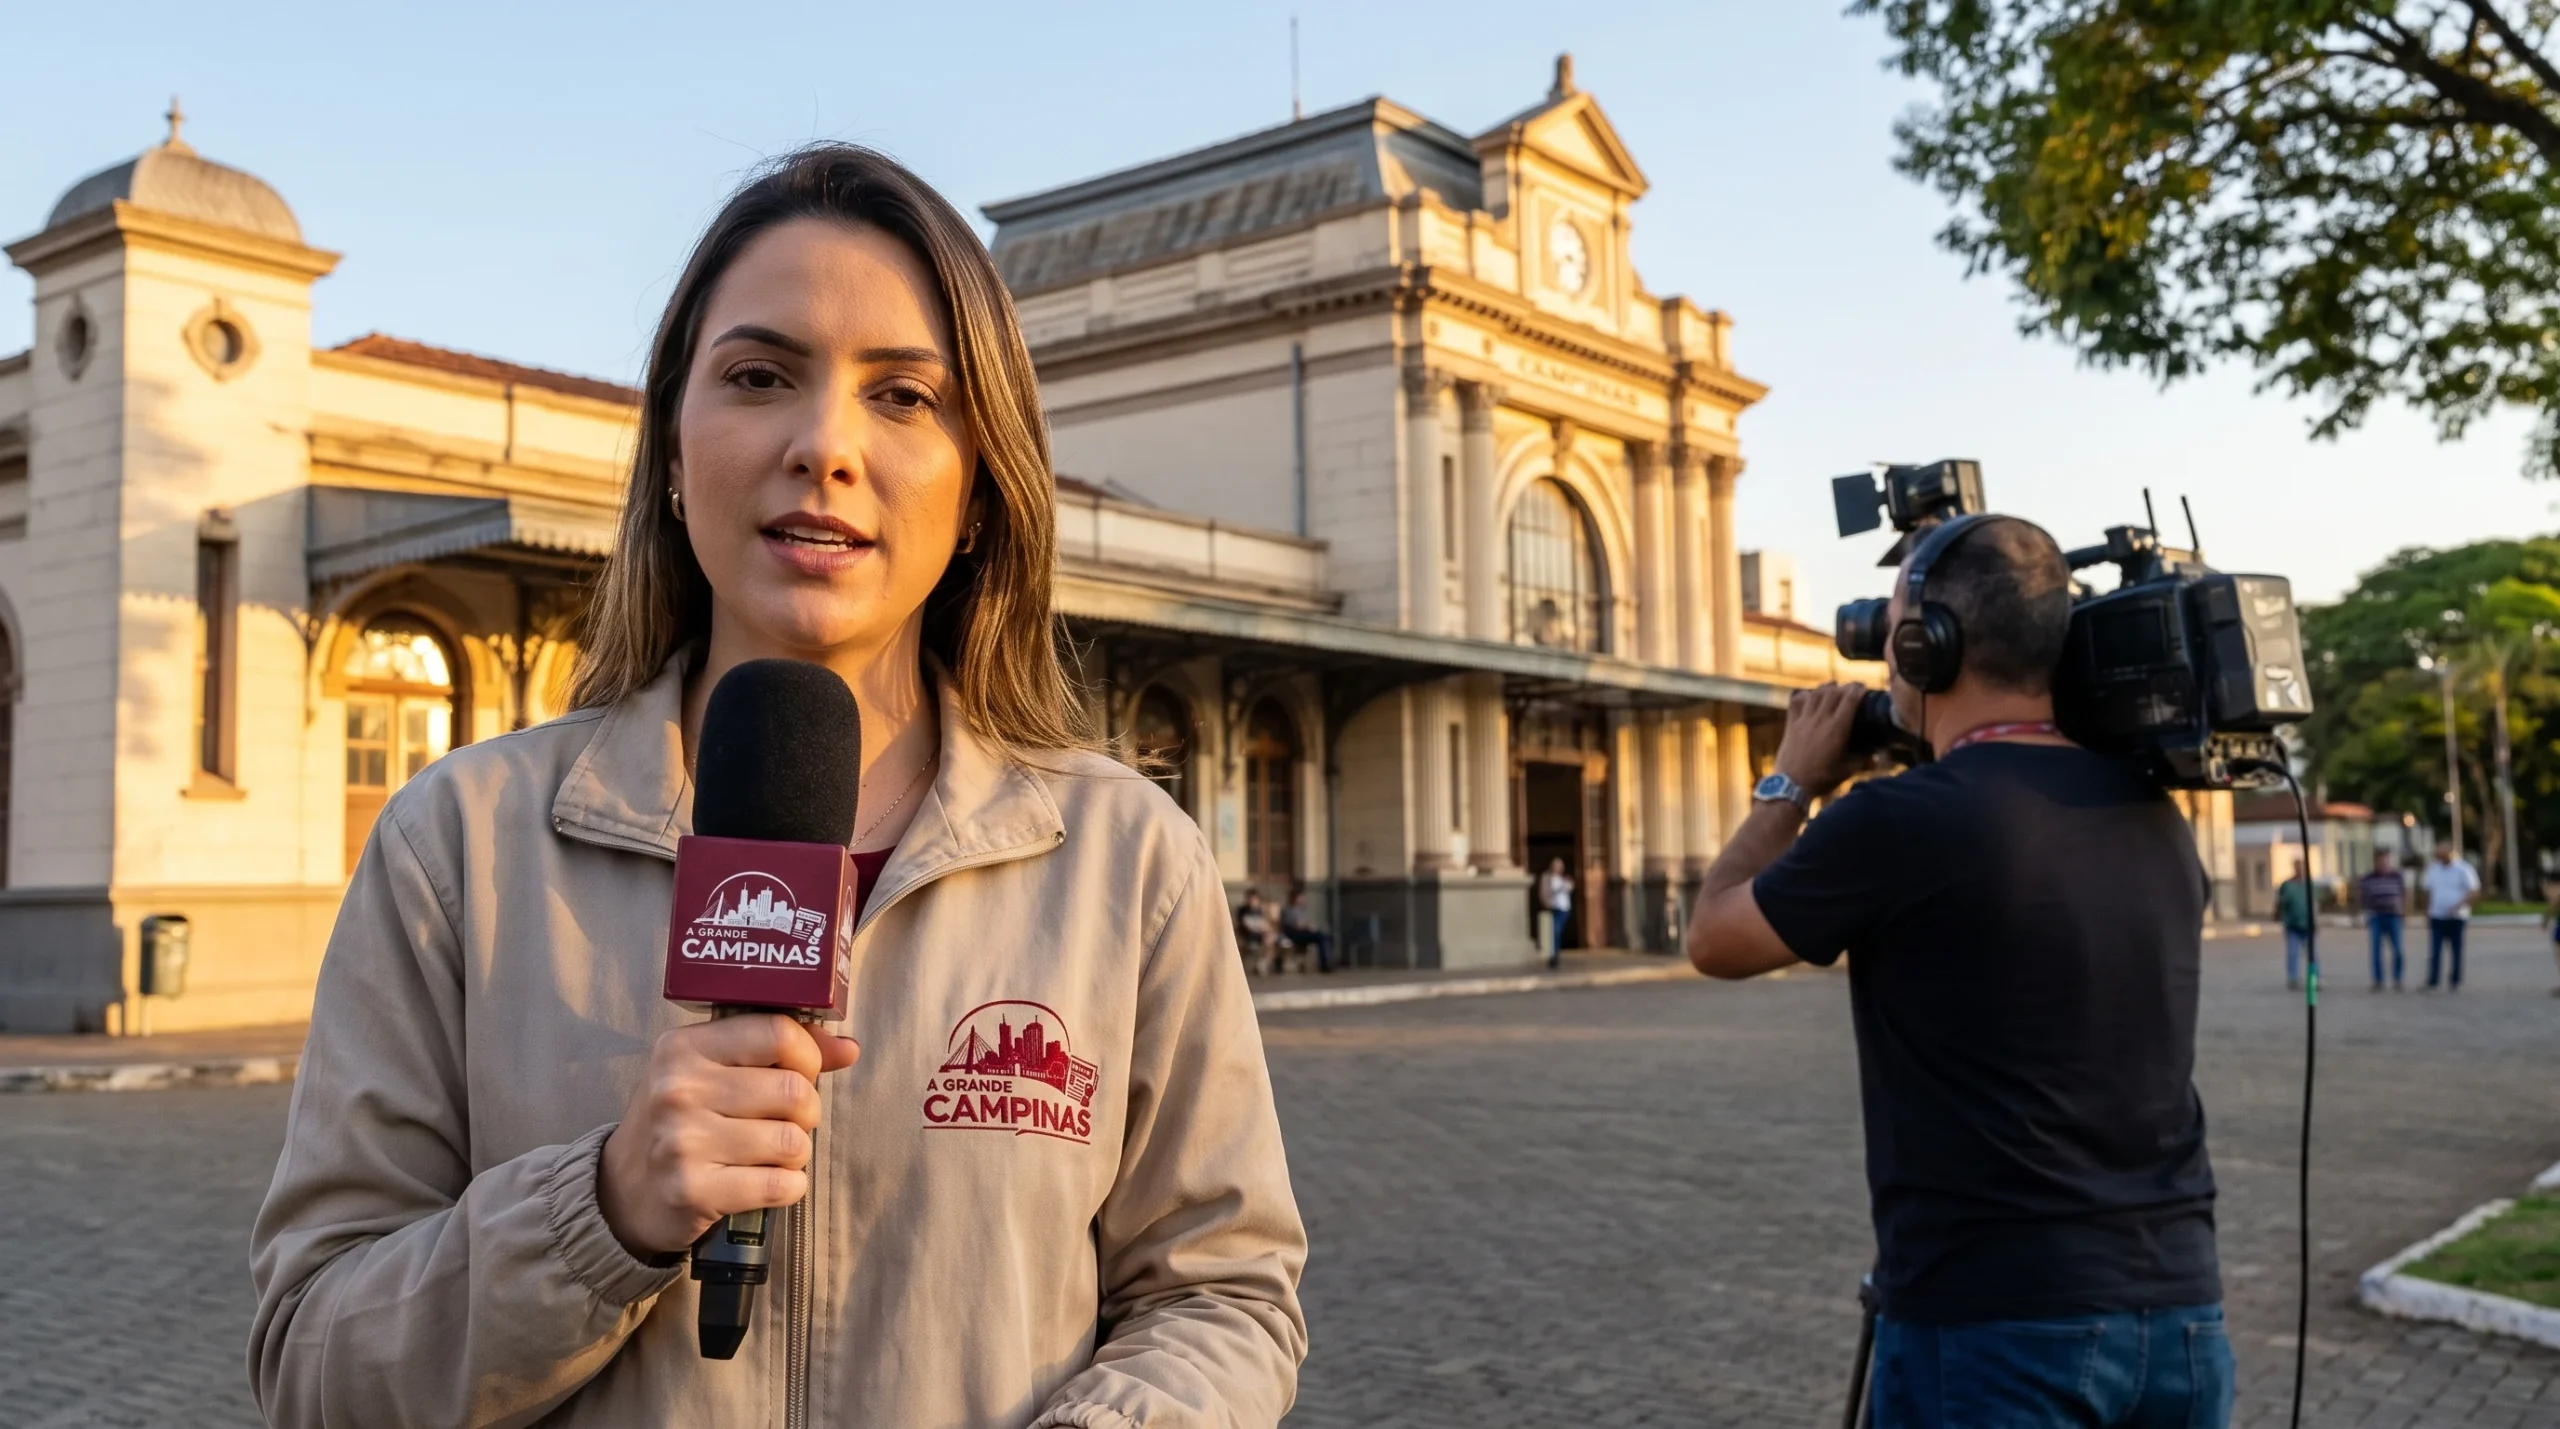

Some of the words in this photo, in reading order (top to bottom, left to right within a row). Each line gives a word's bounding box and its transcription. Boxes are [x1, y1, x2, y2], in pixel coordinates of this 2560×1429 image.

[685, 927, 695, 936] A
[698, 927, 748, 939] GRANDE
[681, 938, 821, 966] CAMPINAS
[926, 1078, 939, 1092] A
[943, 1078, 1013, 1094] GRANDE
[923, 1093, 1092, 1138] CAMPINAS
